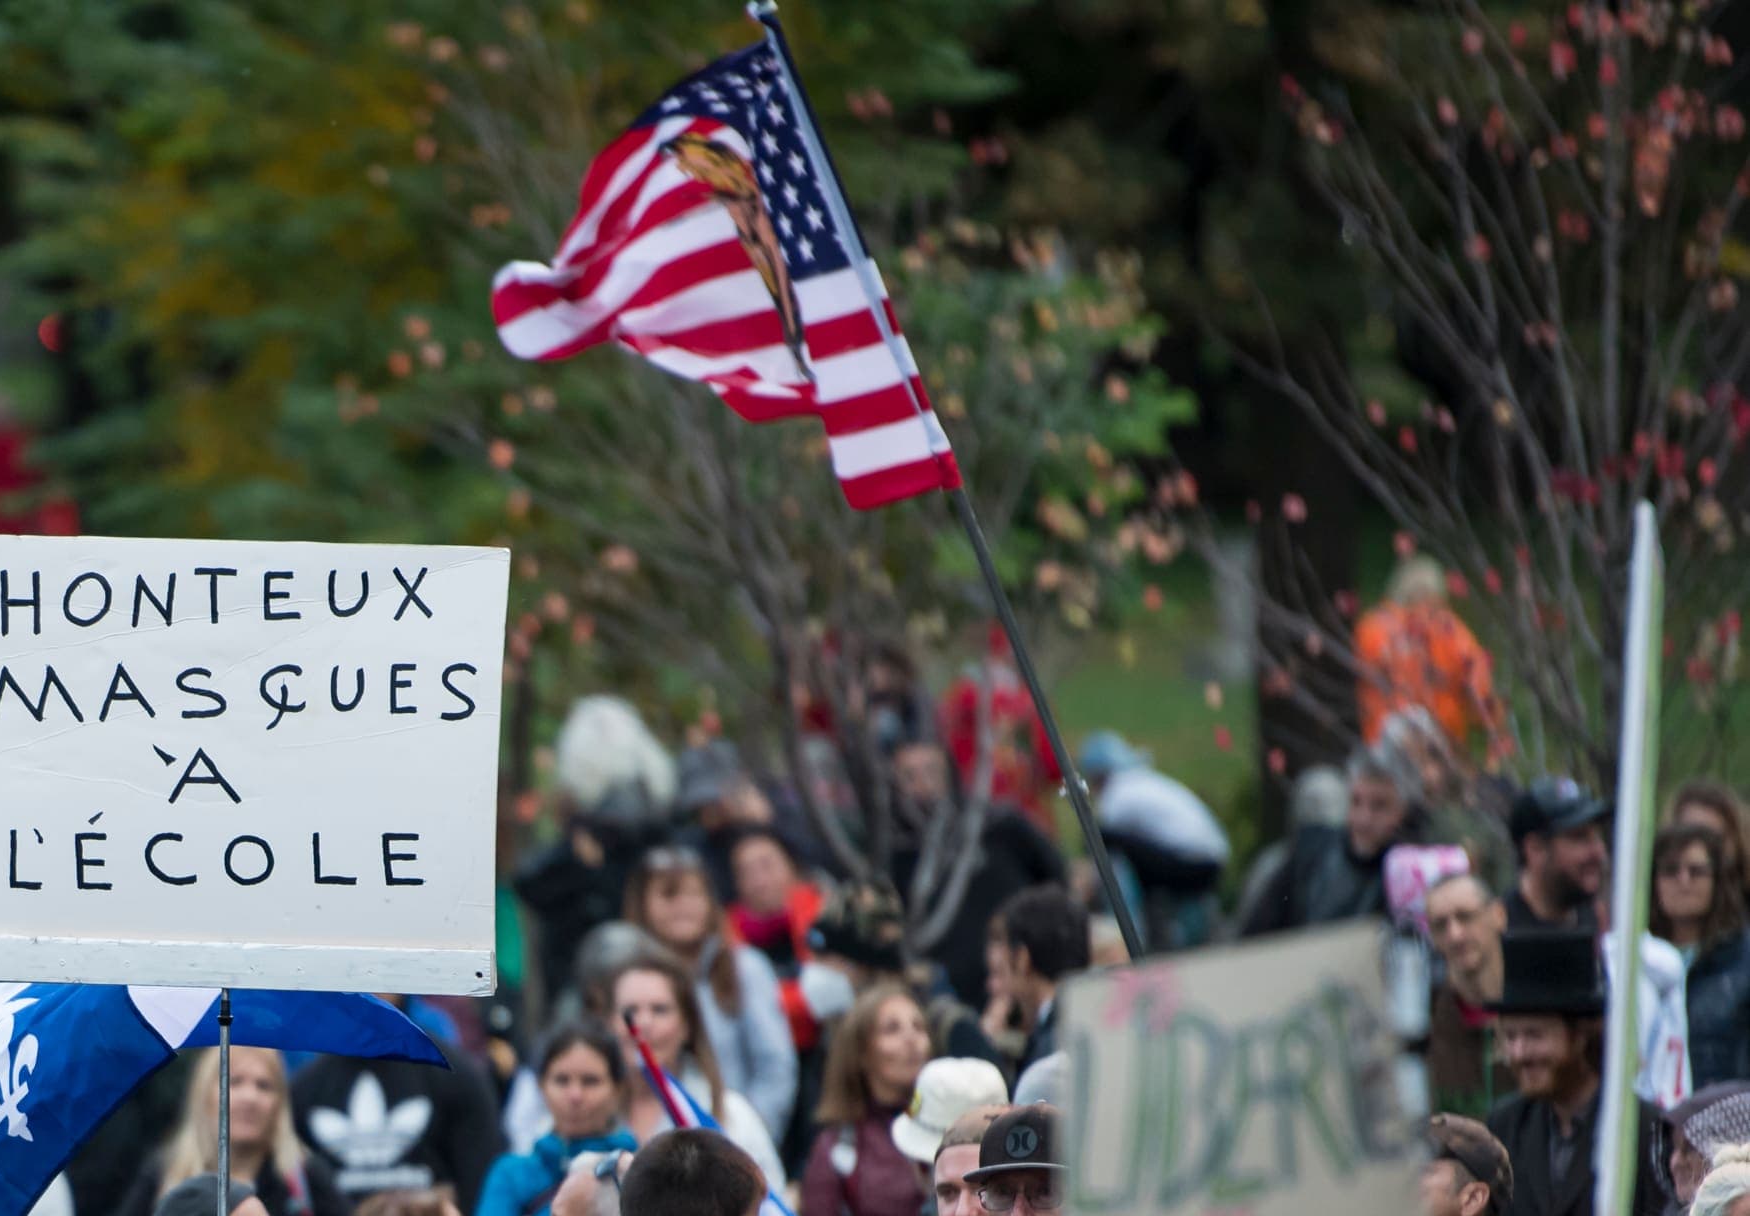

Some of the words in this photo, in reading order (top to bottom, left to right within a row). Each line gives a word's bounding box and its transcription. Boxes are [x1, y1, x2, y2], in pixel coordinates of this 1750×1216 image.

[0, 567, 433, 637] HONTEUX
[153, 745, 242, 804] À
[9, 811, 425, 891] L'ÉCOLE
